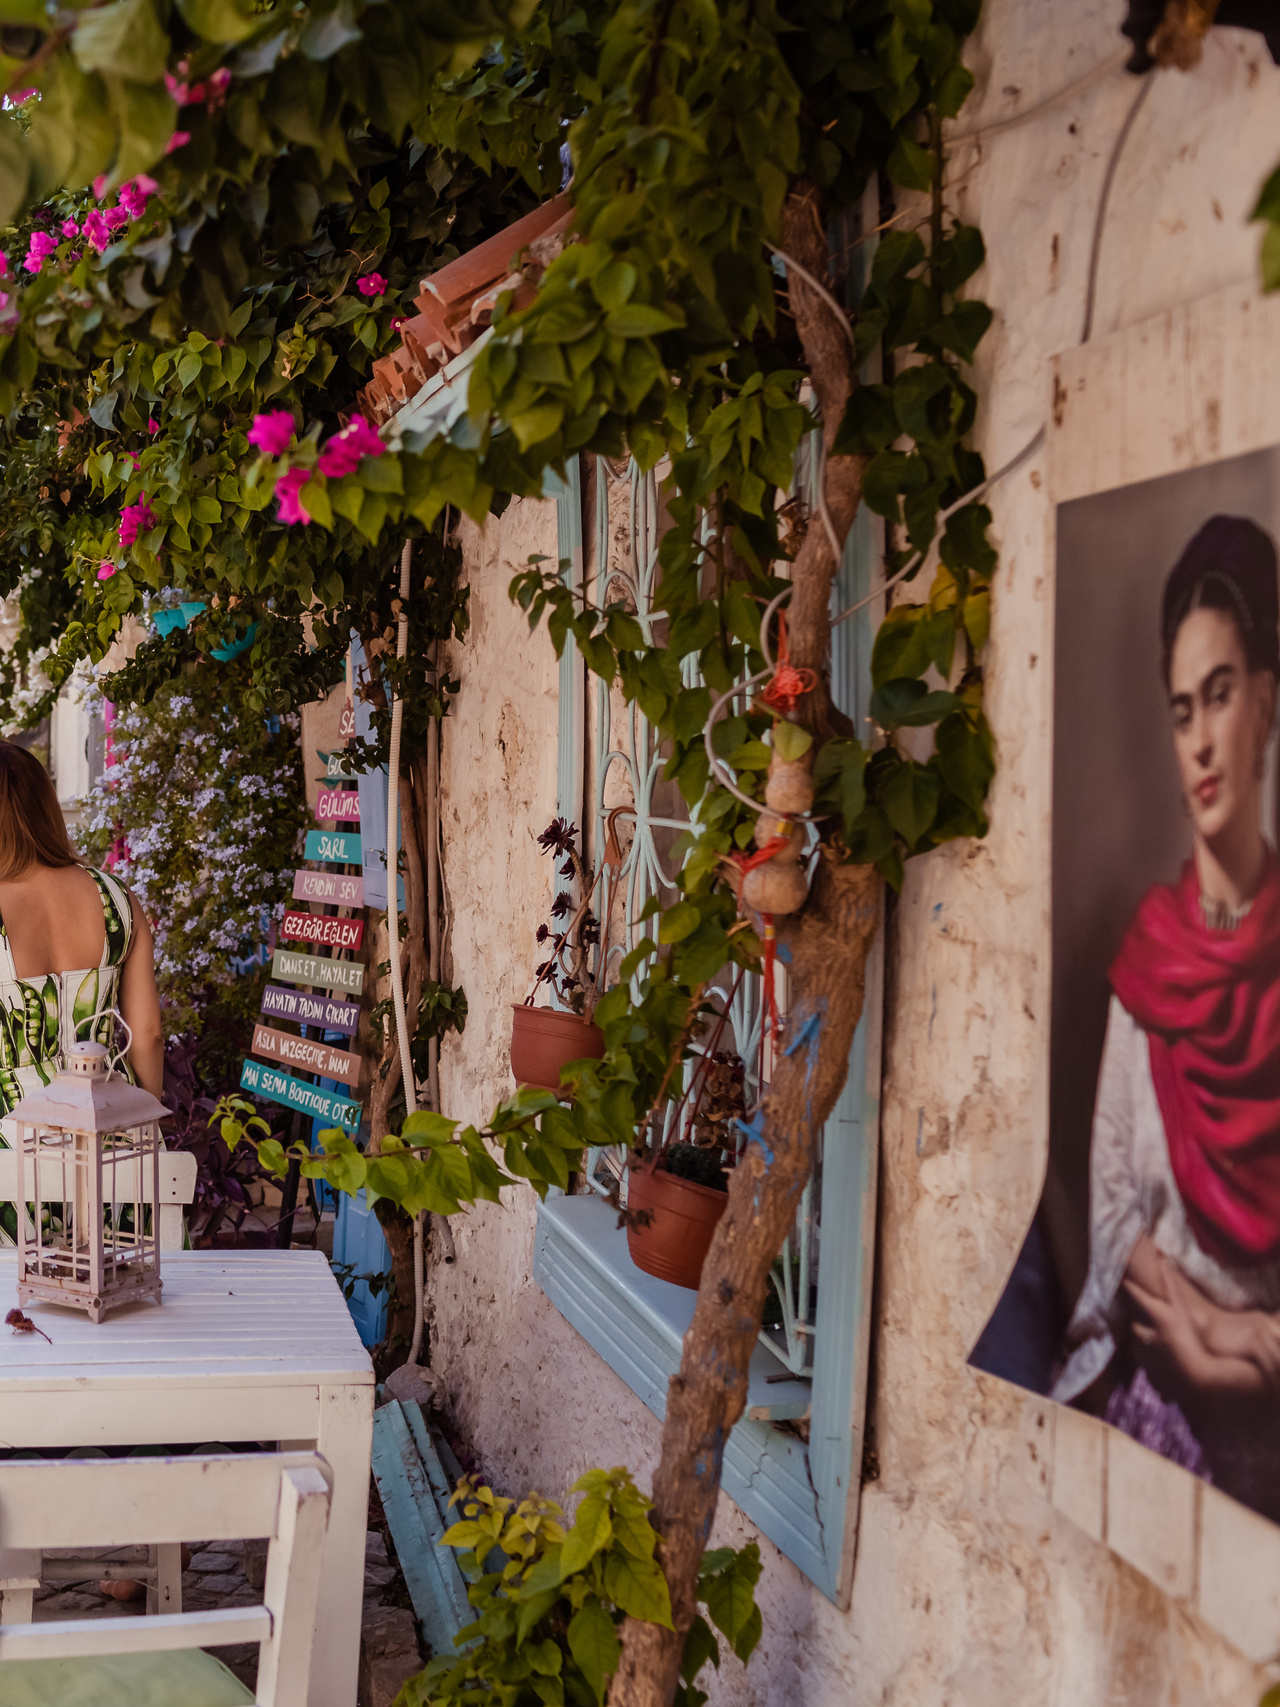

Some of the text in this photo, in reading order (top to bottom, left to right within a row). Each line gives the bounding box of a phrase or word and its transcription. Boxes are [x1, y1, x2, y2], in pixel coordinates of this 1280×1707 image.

[319, 792, 361, 818] GÜLÜMS
[317, 836, 349, 860] SARIL
[339, 881, 359, 900] SEV
[263, 990, 358, 1027] HAYATIN TADINI ÇIKART
[254, 1030, 276, 1051] ASLA
[261, 1072, 287, 1095] SEMA
[287, 1081, 332, 1118] BOUTIQUE
[331, 1103, 358, 1128] OTE
